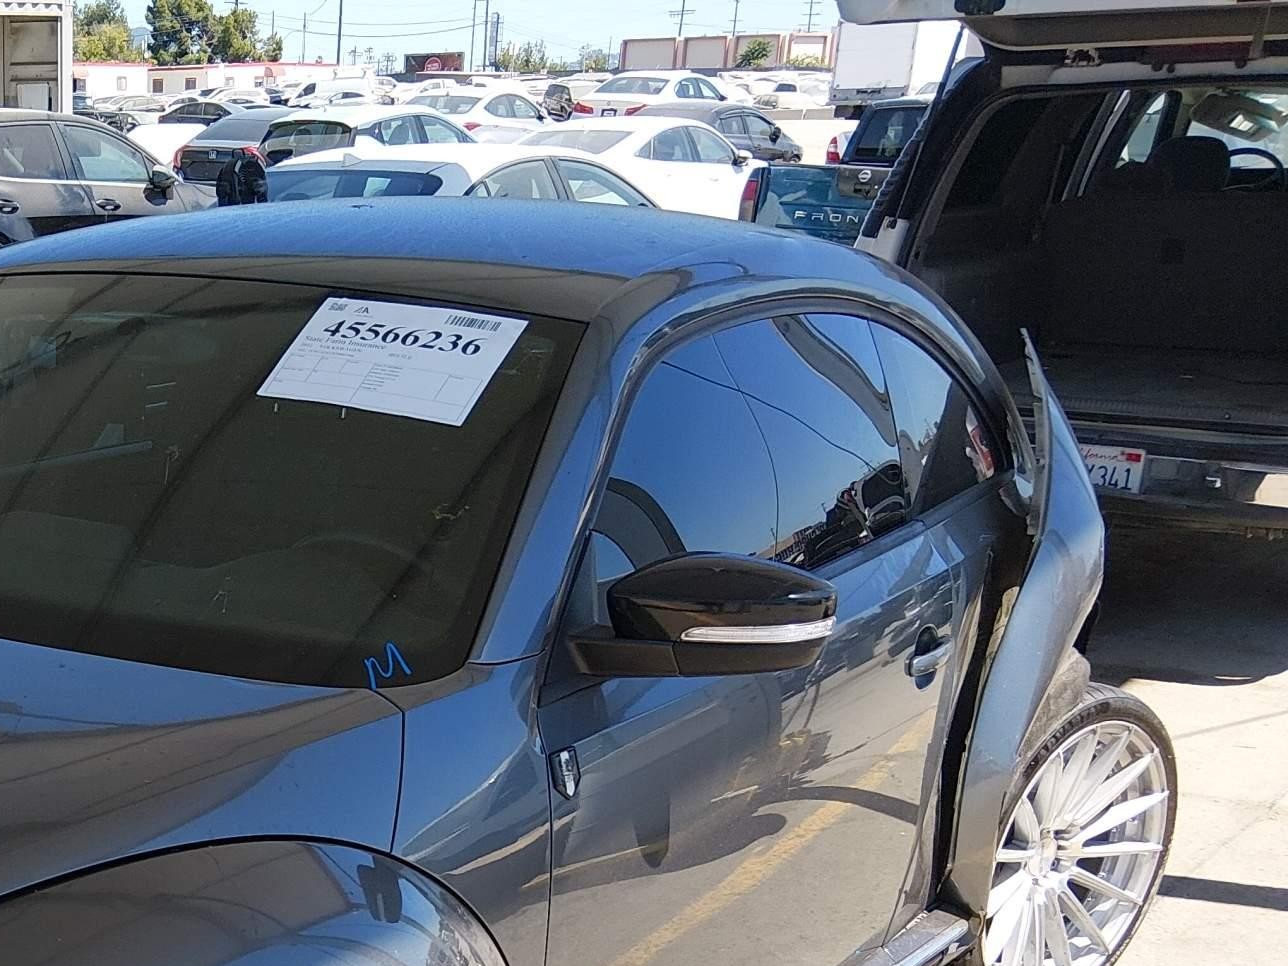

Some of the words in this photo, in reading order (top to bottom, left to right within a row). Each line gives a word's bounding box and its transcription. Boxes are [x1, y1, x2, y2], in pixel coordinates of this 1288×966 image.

[794, 210, 859, 223] FRON
[305, 335, 323, 343] State
[325, 337, 346, 345] Farm
[348, 339, 387, 350] Insurance
[323, 319, 488, 355] 45566236
